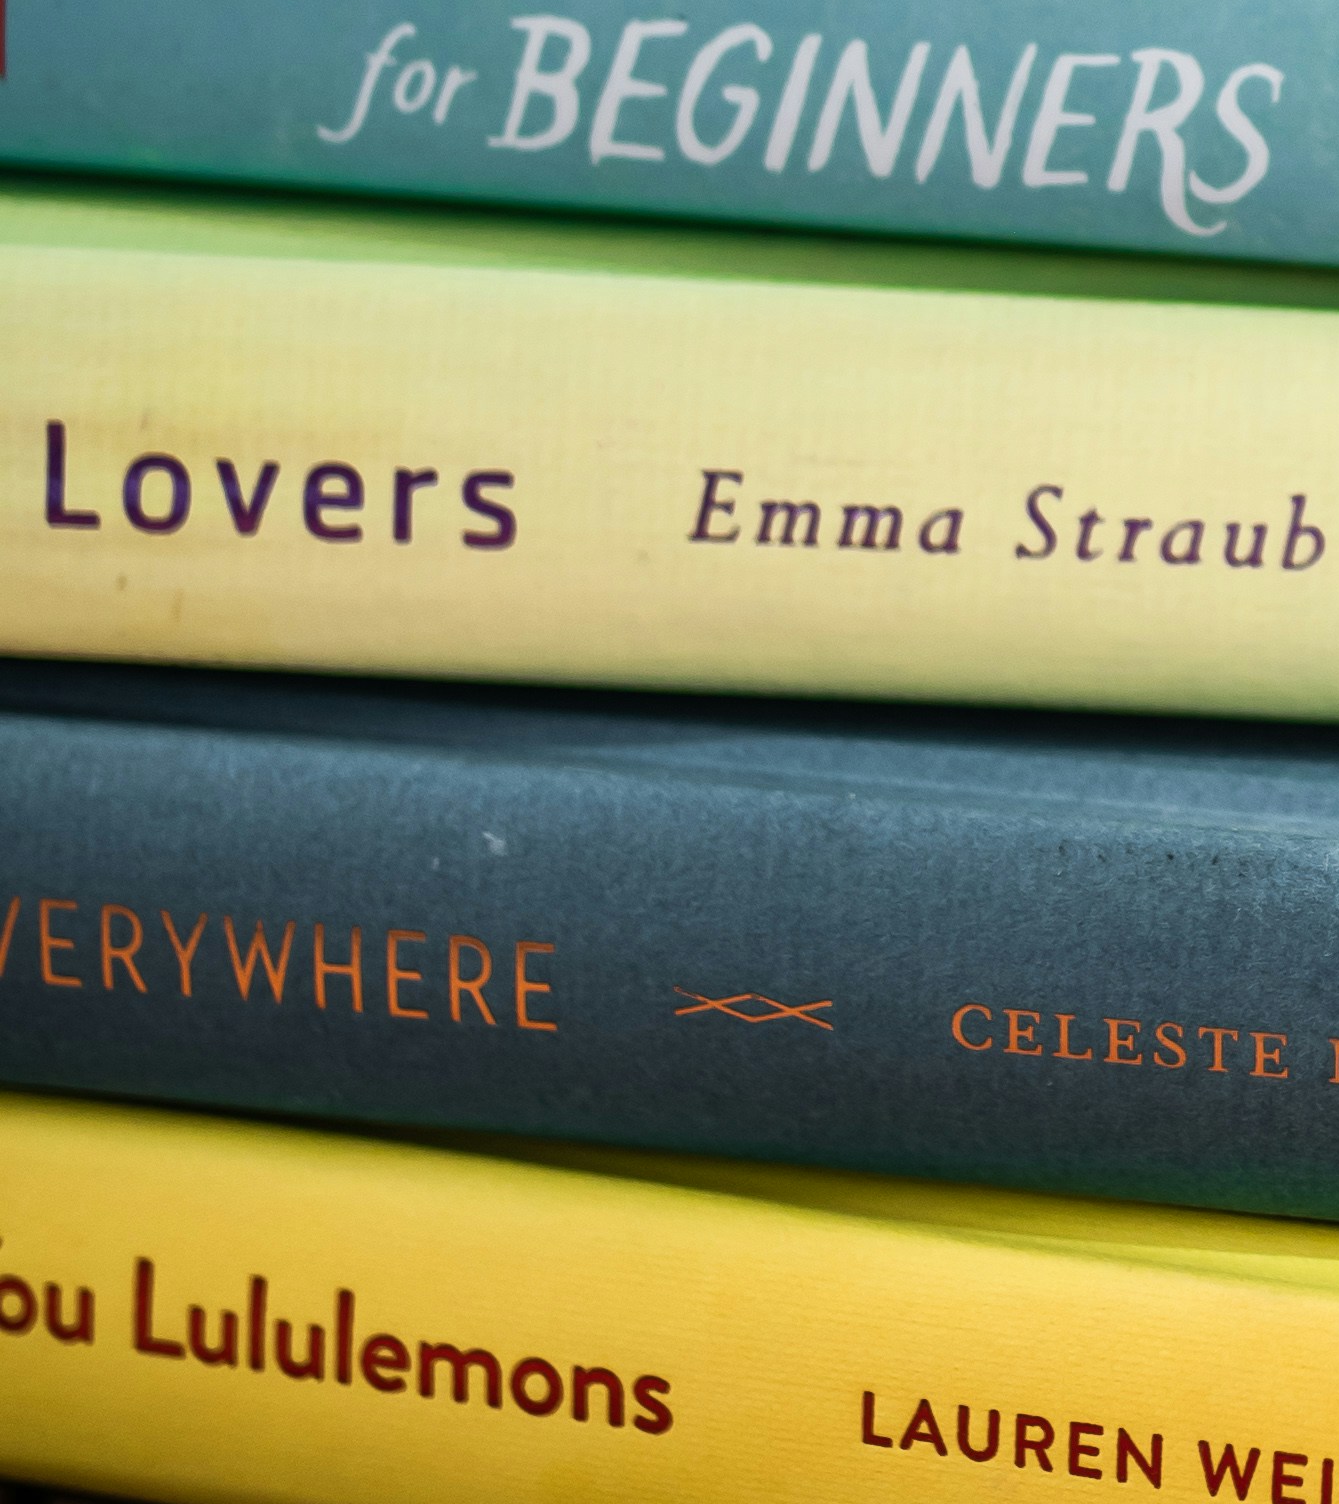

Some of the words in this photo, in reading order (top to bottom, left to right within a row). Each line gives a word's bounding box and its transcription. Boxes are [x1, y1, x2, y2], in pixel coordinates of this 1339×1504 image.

[316, 22, 478, 144] for
[486, 14, 1285, 236] BEGINNERS
[44, 419, 520, 551] Lovers
[686, 468, 964, 556] Emma
[1014, 482, 1328, 572] Straub
[950, 1003, 1290, 1080] CELESTE
[0, 1232, 95, 1346] ou
[132, 1255, 676, 1436] Lululemons
[860, 1390, 1164, 1492] LAUREN
